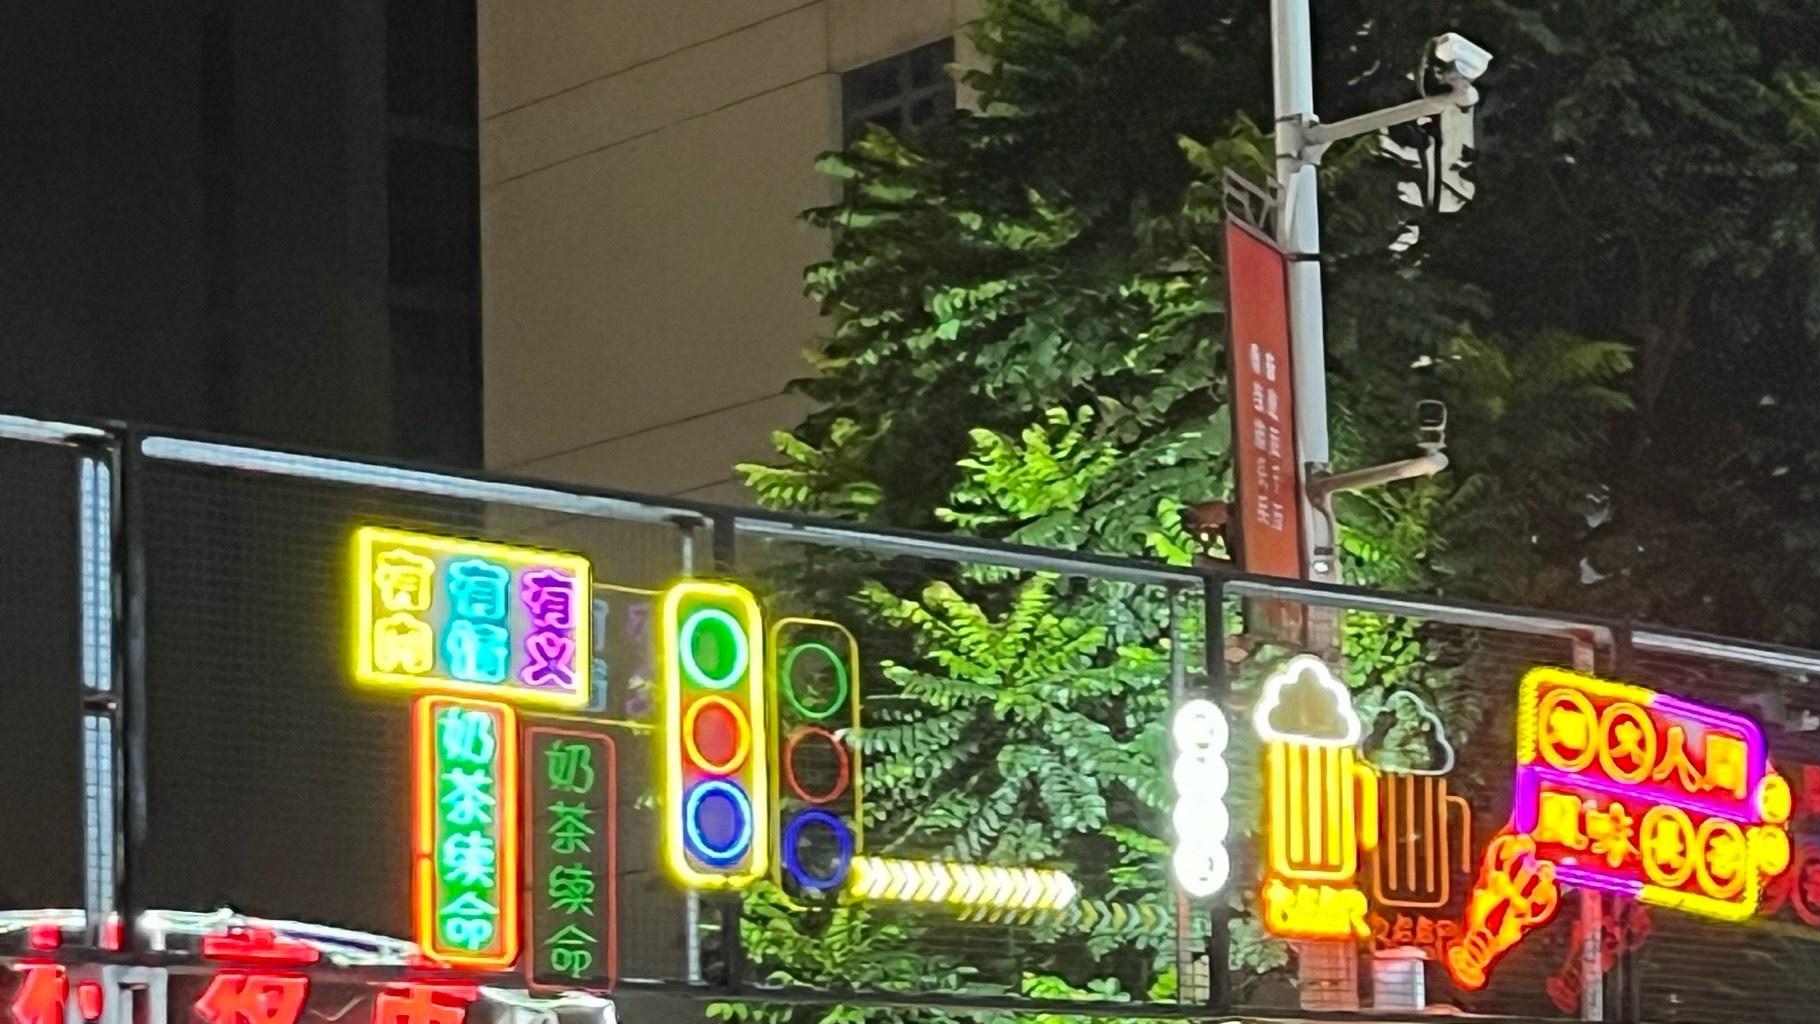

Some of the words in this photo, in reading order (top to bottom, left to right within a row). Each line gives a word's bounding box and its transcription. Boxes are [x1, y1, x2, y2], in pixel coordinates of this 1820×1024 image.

[437, 706, 500, 951] 奶茶续命
[545, 738, 596, 980] 奶茶续命
